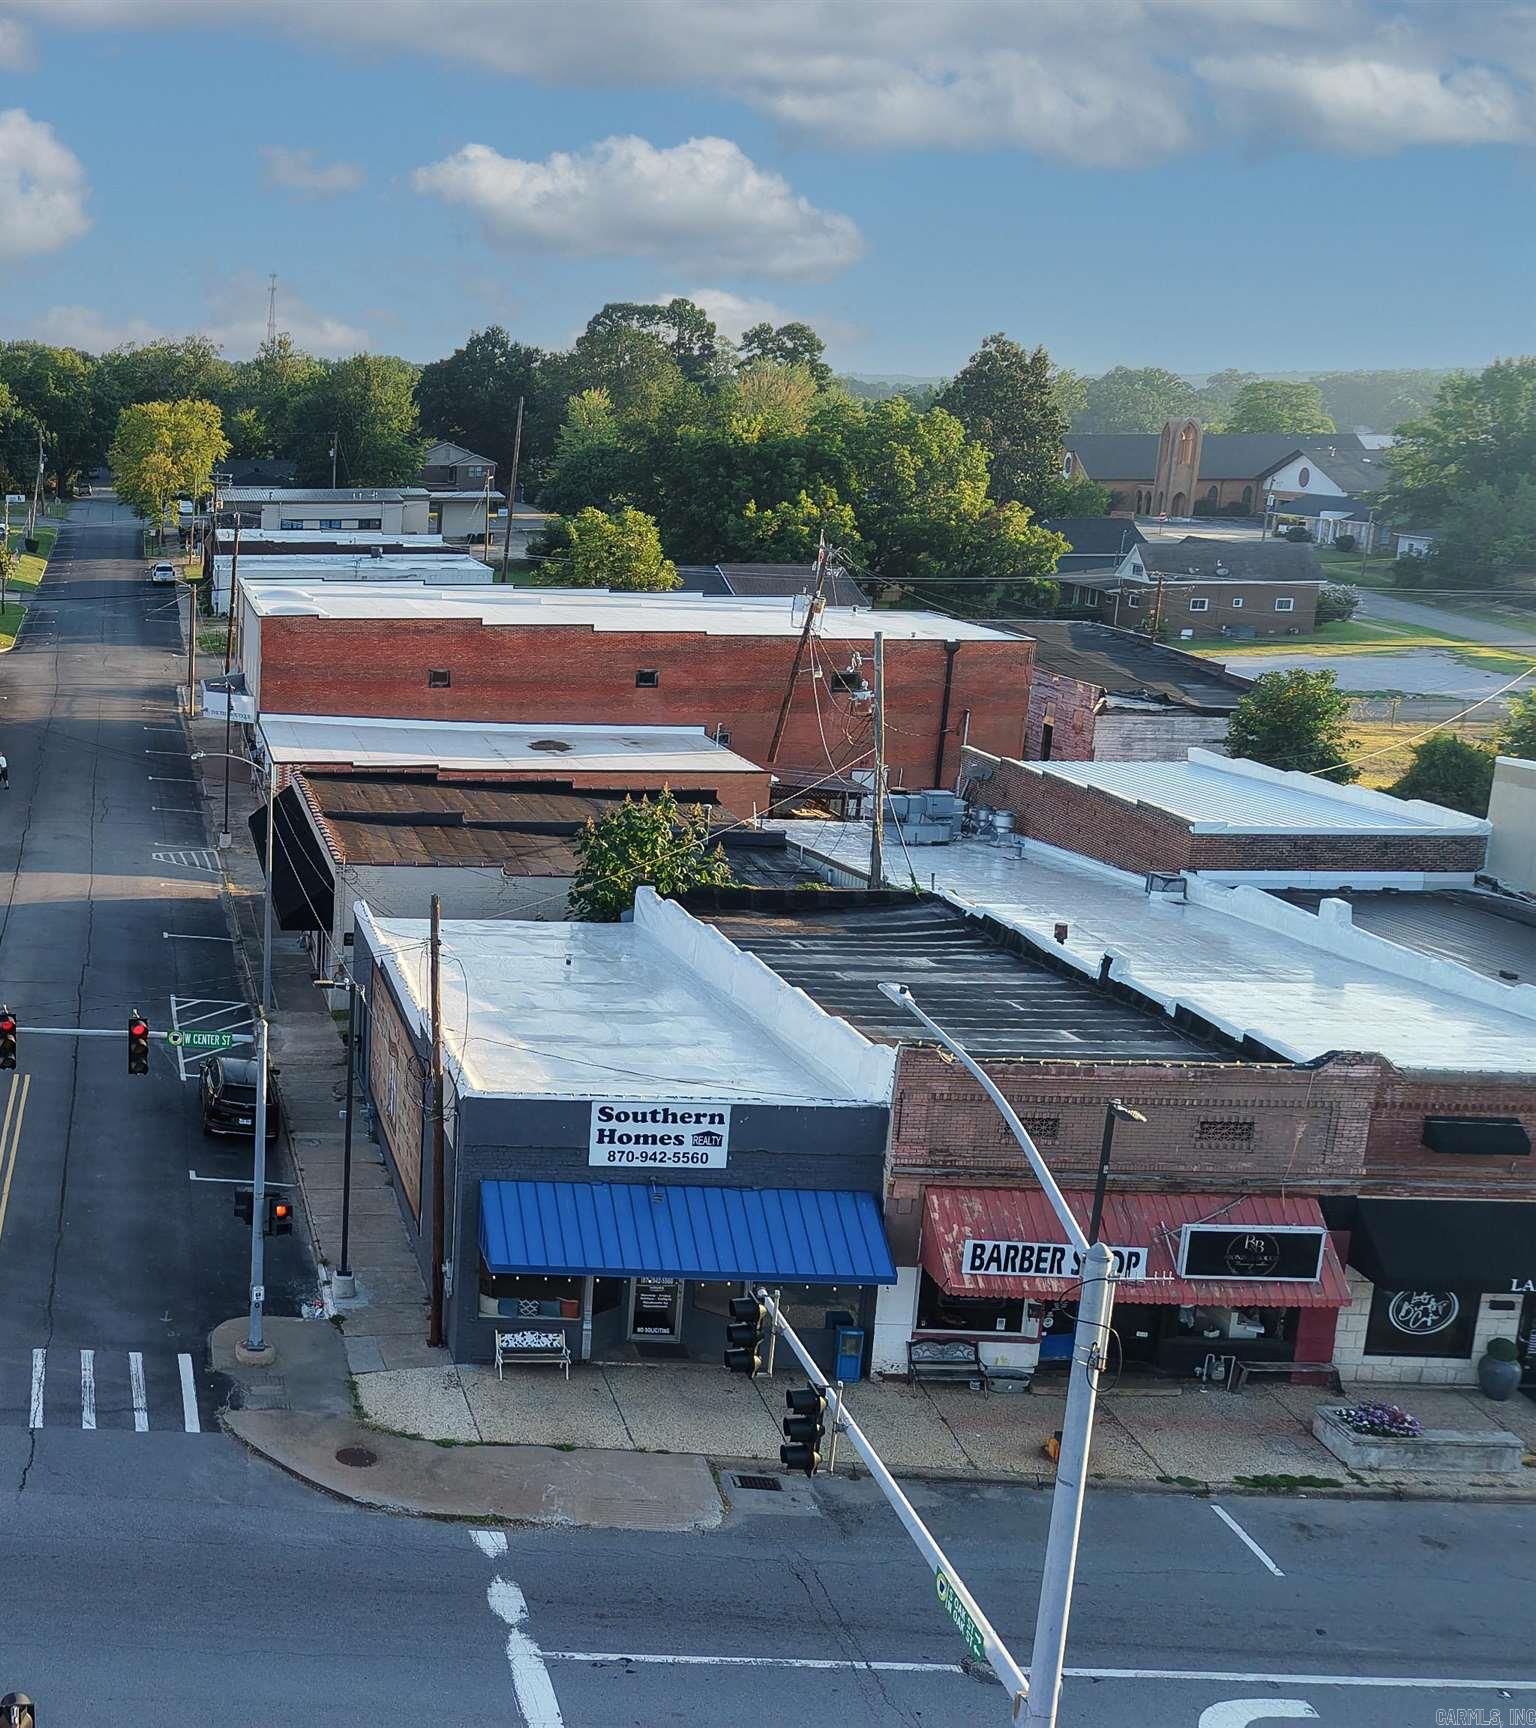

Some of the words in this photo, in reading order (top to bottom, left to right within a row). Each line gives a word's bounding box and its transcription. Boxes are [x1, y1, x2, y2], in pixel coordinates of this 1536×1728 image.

[185, 1033, 191, 1044] W
[193, 1034, 220, 1045] CENTER
[222, 1034, 231, 1046] ST
[597, 1106, 725, 1125] Southern
[596, 1128, 685, 1146] Homes
[693, 1135, 722, 1147] REALTY
[607, 1151, 709, 1164] 870-942-5560
[970, 1243, 1066, 1275] BARBER
[1071, 1249, 1140, 1277] SOP
[953, 1610, 965, 1635] OAK
[954, 1597, 966, 1623] OAK
[967, 1617, 975, 1635] ST
